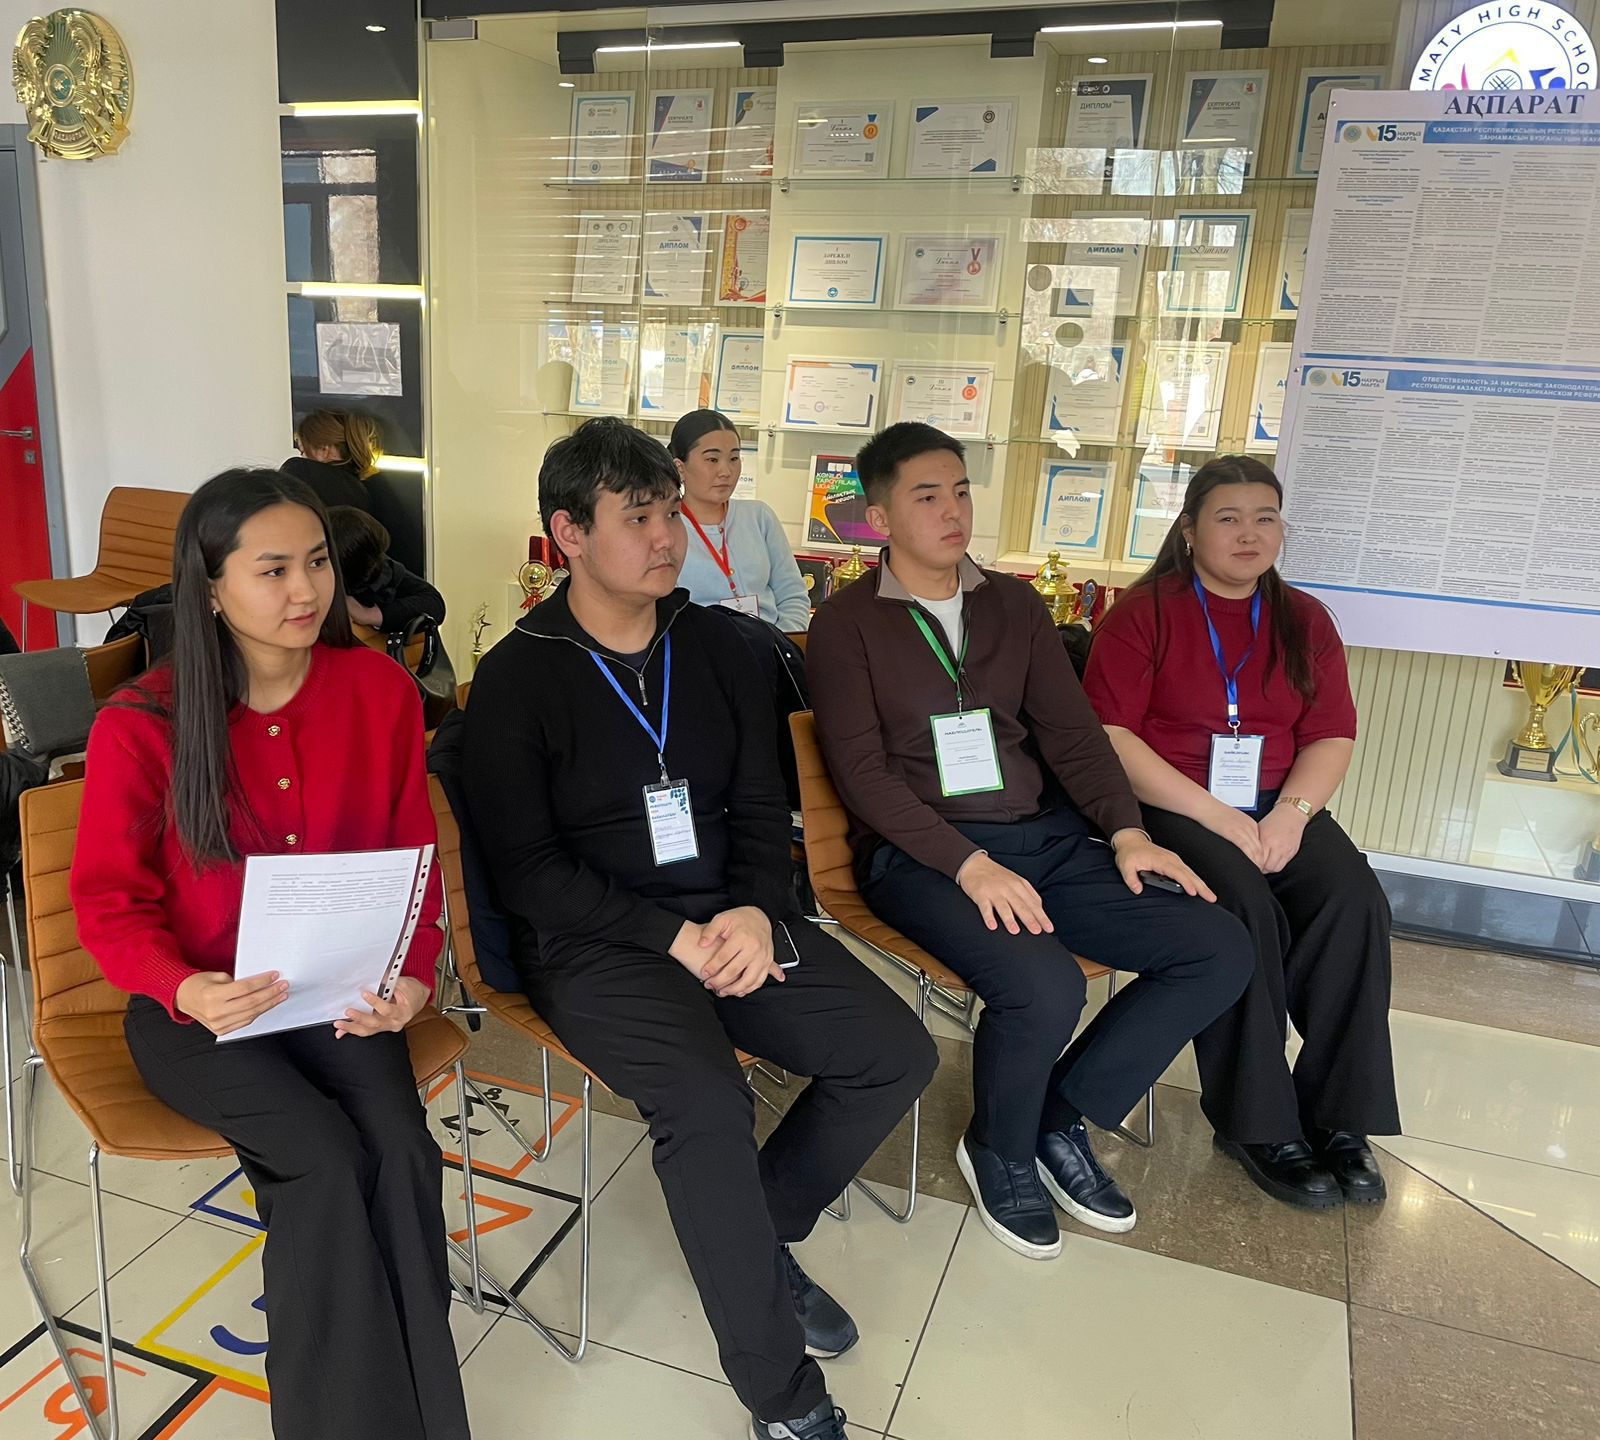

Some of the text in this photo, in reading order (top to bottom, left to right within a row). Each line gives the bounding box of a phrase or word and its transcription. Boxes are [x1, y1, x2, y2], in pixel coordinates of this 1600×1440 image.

[1418, 5, 1590, 90] MATY HIGH SCHOO
[1080, 102, 1112, 110] ДИПЛОМ
[1444, 94, 1585, 118] АҚПАРАТ
[1377, 124, 1397, 142] 15
[658, 242, 689, 250] ДИПЛОМ
[1086, 246, 1124, 254] ДИПЛОМ
[1342, 370, 1361, 388] 15
[1421, 376, 1489, 386] ОТВЕТСТВЕННОСТЬ
[1500, 380, 1543, 388] НАРУШЕНИЕ
[1411, 382, 1456, 391] РЕСПУБЛИКИ
[1456, 385, 1496, 393] КАЗАХСТАН
[1503, 387, 1573, 397] РЕСПУБЛИКАНСКОМ
[1057, 495, 1091, 503] ДИПЛОМ
